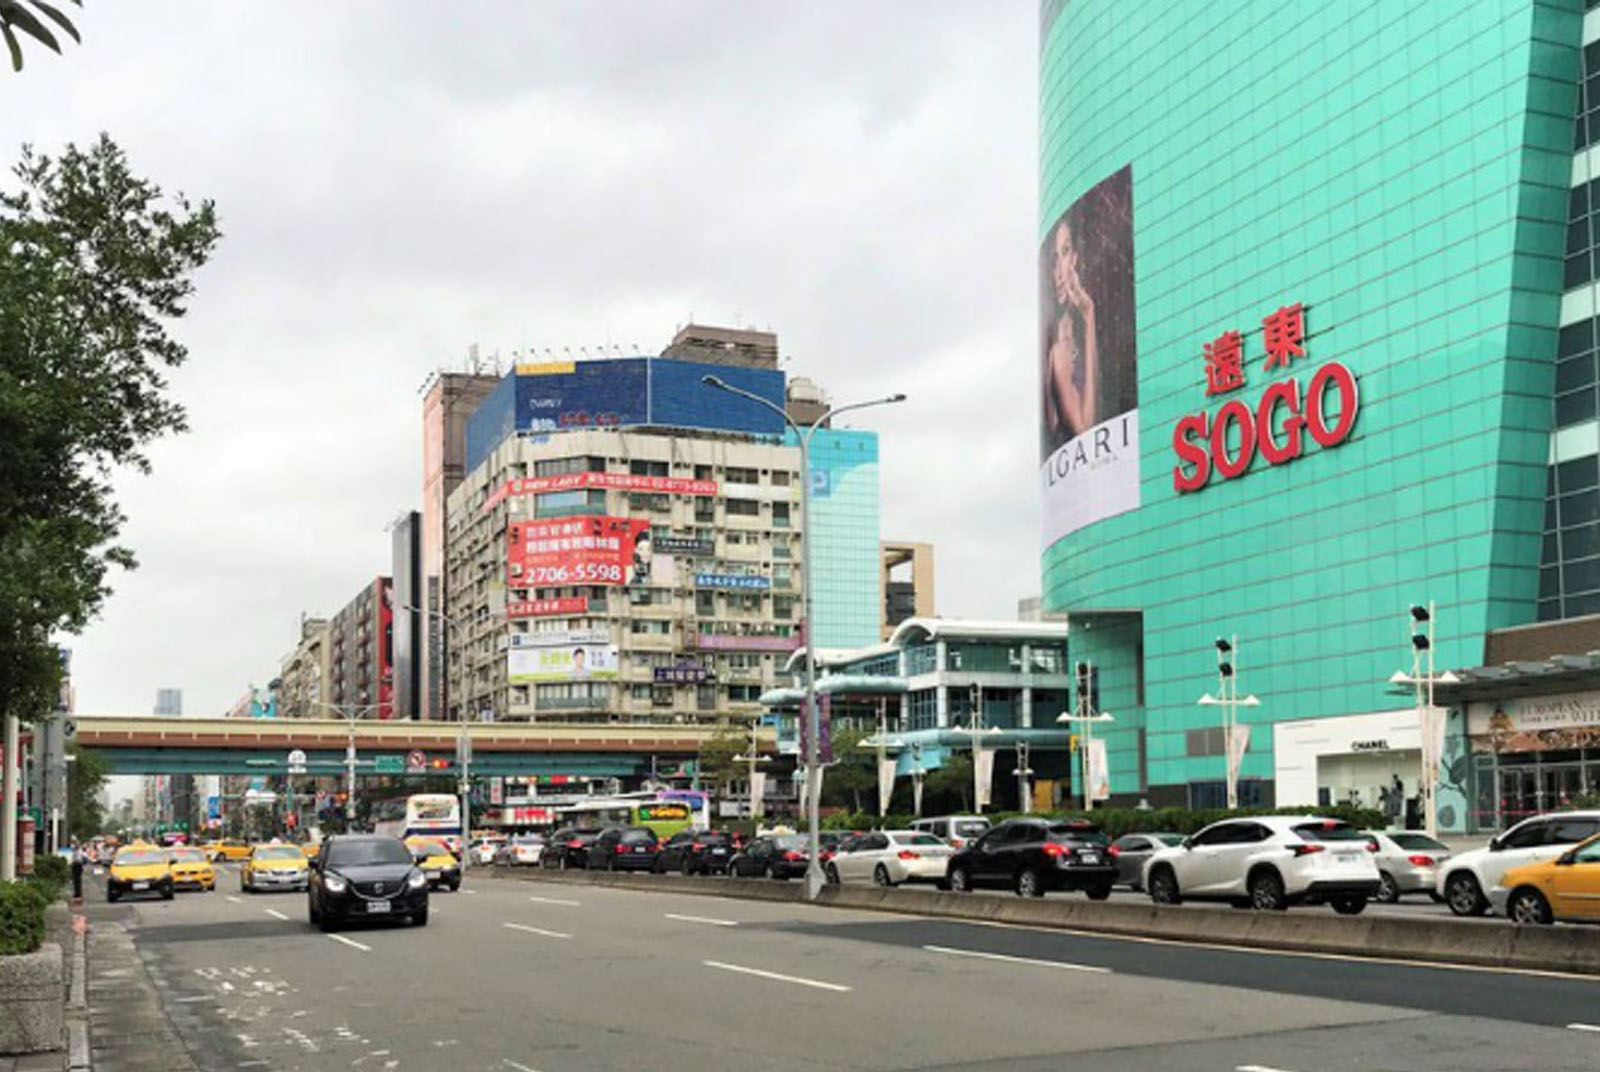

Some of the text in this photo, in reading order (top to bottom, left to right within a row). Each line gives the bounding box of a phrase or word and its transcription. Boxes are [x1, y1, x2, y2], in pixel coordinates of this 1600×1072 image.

[1203, 302, 1307, 397] 遠東
[1173, 362, 1359, 494] SOGO
[525, 564, 622, 583] 2706-5598
[1351, 738, 1390, 752] CHANEL
